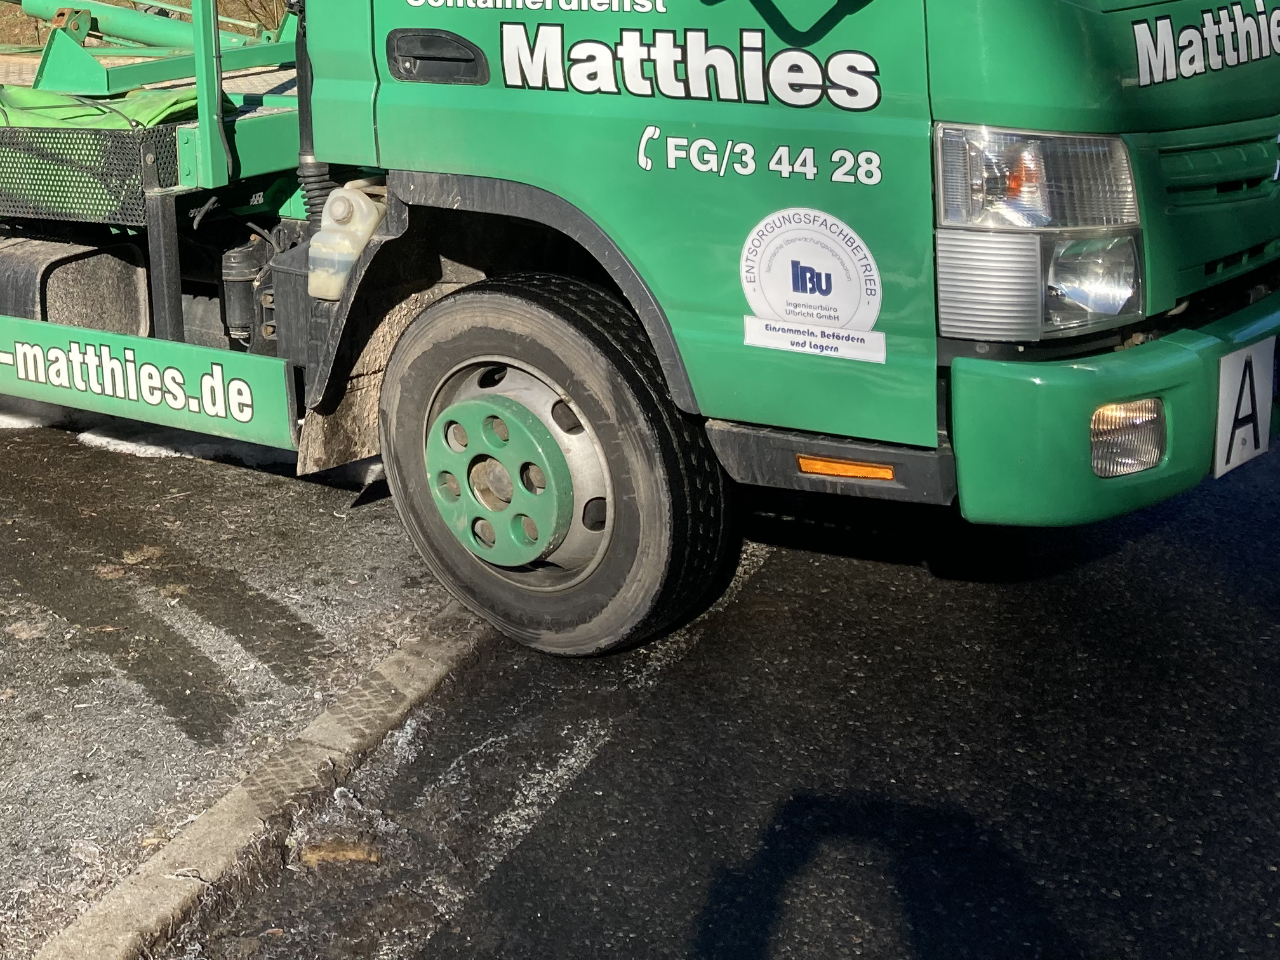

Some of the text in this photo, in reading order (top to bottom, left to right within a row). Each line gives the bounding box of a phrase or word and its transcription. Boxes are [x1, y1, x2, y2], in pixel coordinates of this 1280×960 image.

[500, 21, 882, 112] Matthies
[666, 137, 883, 186] FG/3 44 28
[745, 212, 877, 297] ENTSORGUNGSFACHBETRIEB
[786, 300, 838, 313] Ingenieurbüro
[816, 312, 840, 321] GmbH
[790, 340, 807, 348] und
[820, 331, 866, 344] Befördern
[1225, 354, 1261, 466] A
